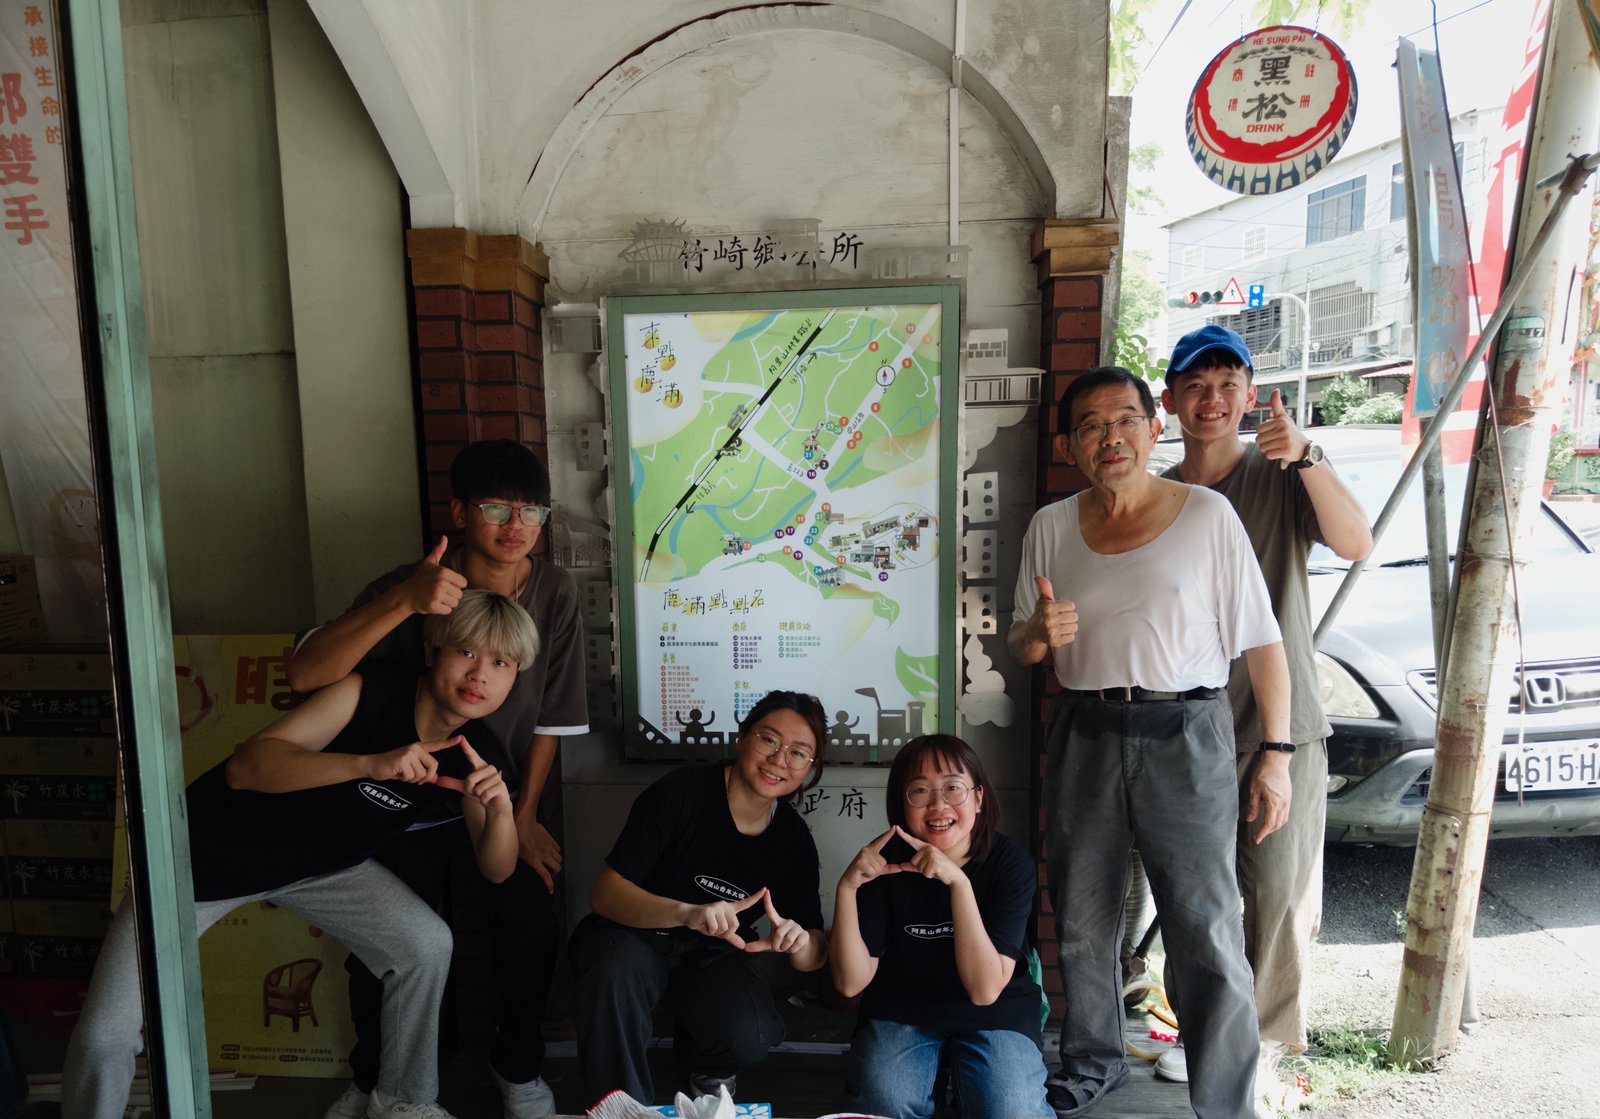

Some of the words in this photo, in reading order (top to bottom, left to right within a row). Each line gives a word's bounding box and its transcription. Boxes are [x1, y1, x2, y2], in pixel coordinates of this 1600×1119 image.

[1253, 38, 1264, 46] HE
[1266, 36, 1291, 45] SUNG
[1291, 34, 1306, 43] PAI
[24, 6, 62, 146] 承接生命的
[1242, 55, 1296, 122] 黑松
[1246, 123, 1285, 133] DRINK
[663, 588, 765, 616] 鹿滿點點名
[31, 698, 80, 715] 竹炭水
[1508, 752, 1600, 784] 4615·H
[39, 783, 87, 800] 竹炭水
[47, 865, 94, 881] 竹炭水
